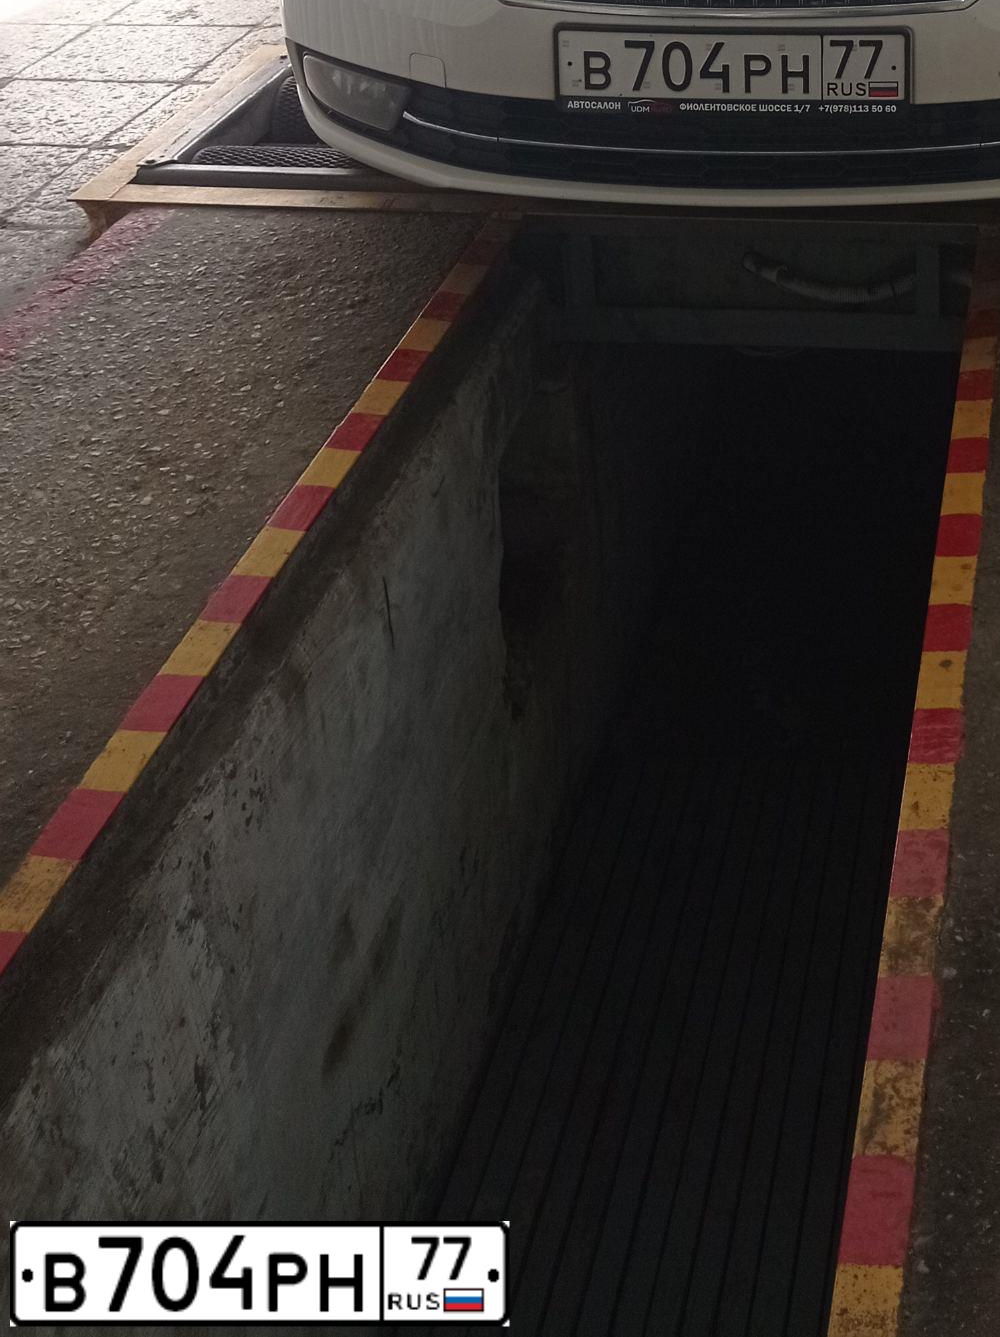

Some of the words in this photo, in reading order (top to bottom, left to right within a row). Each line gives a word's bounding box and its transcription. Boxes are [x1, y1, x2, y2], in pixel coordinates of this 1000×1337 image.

[829, 39, 884, 80] 77
[827, 82, 867, 97] RUS
[567, 100, 621, 110] АВТОСАЛОН
[679, 102, 757, 112] ФИОЛЕНТОВСКОЕ
[758, 104, 791, 112] ШОССЕ
[793, 104, 811, 113] 1/7
